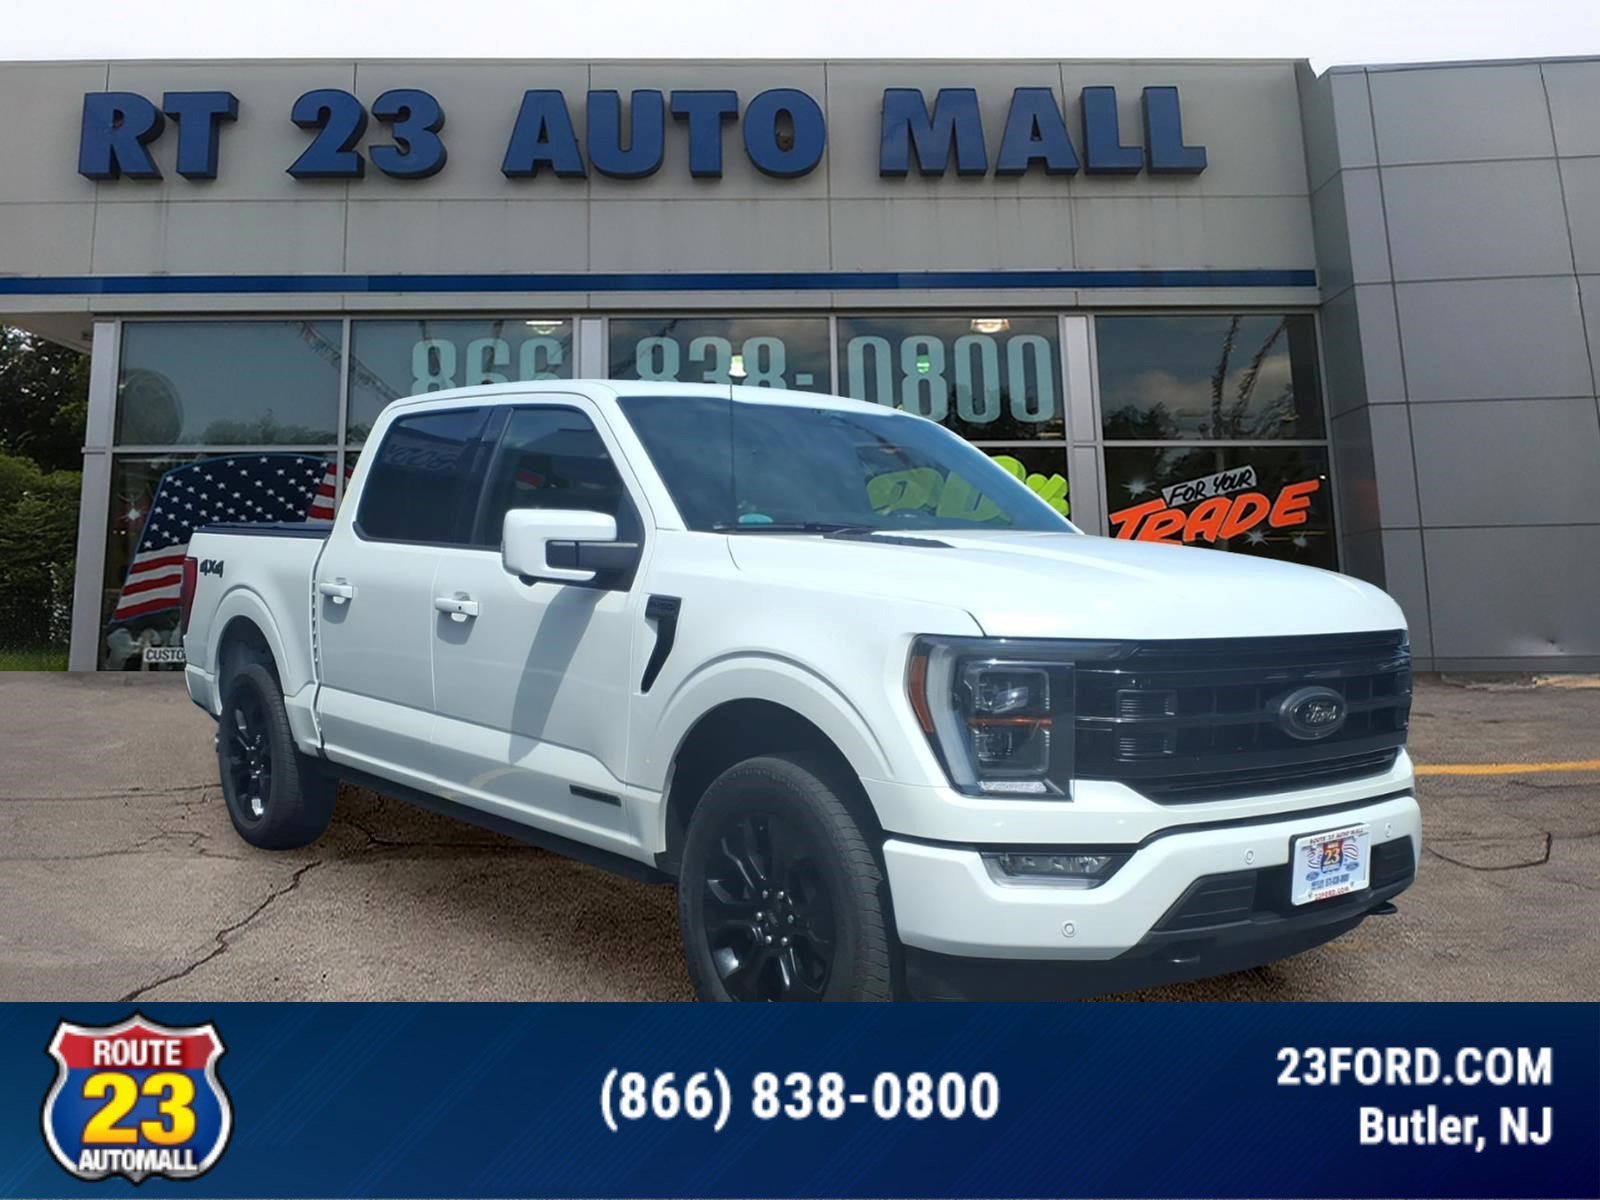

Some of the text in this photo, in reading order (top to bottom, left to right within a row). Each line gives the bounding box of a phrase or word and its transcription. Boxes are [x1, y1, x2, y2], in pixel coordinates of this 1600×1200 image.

[78, 86, 1208, 180] RT 23 AUTO MALL
[1168, 468, 1253, 505] FOR YOUR
[1109, 479, 1320, 546] TRADE
[146, 648, 185, 661] CUSTO
[1324, 848, 1340, 865] 23
